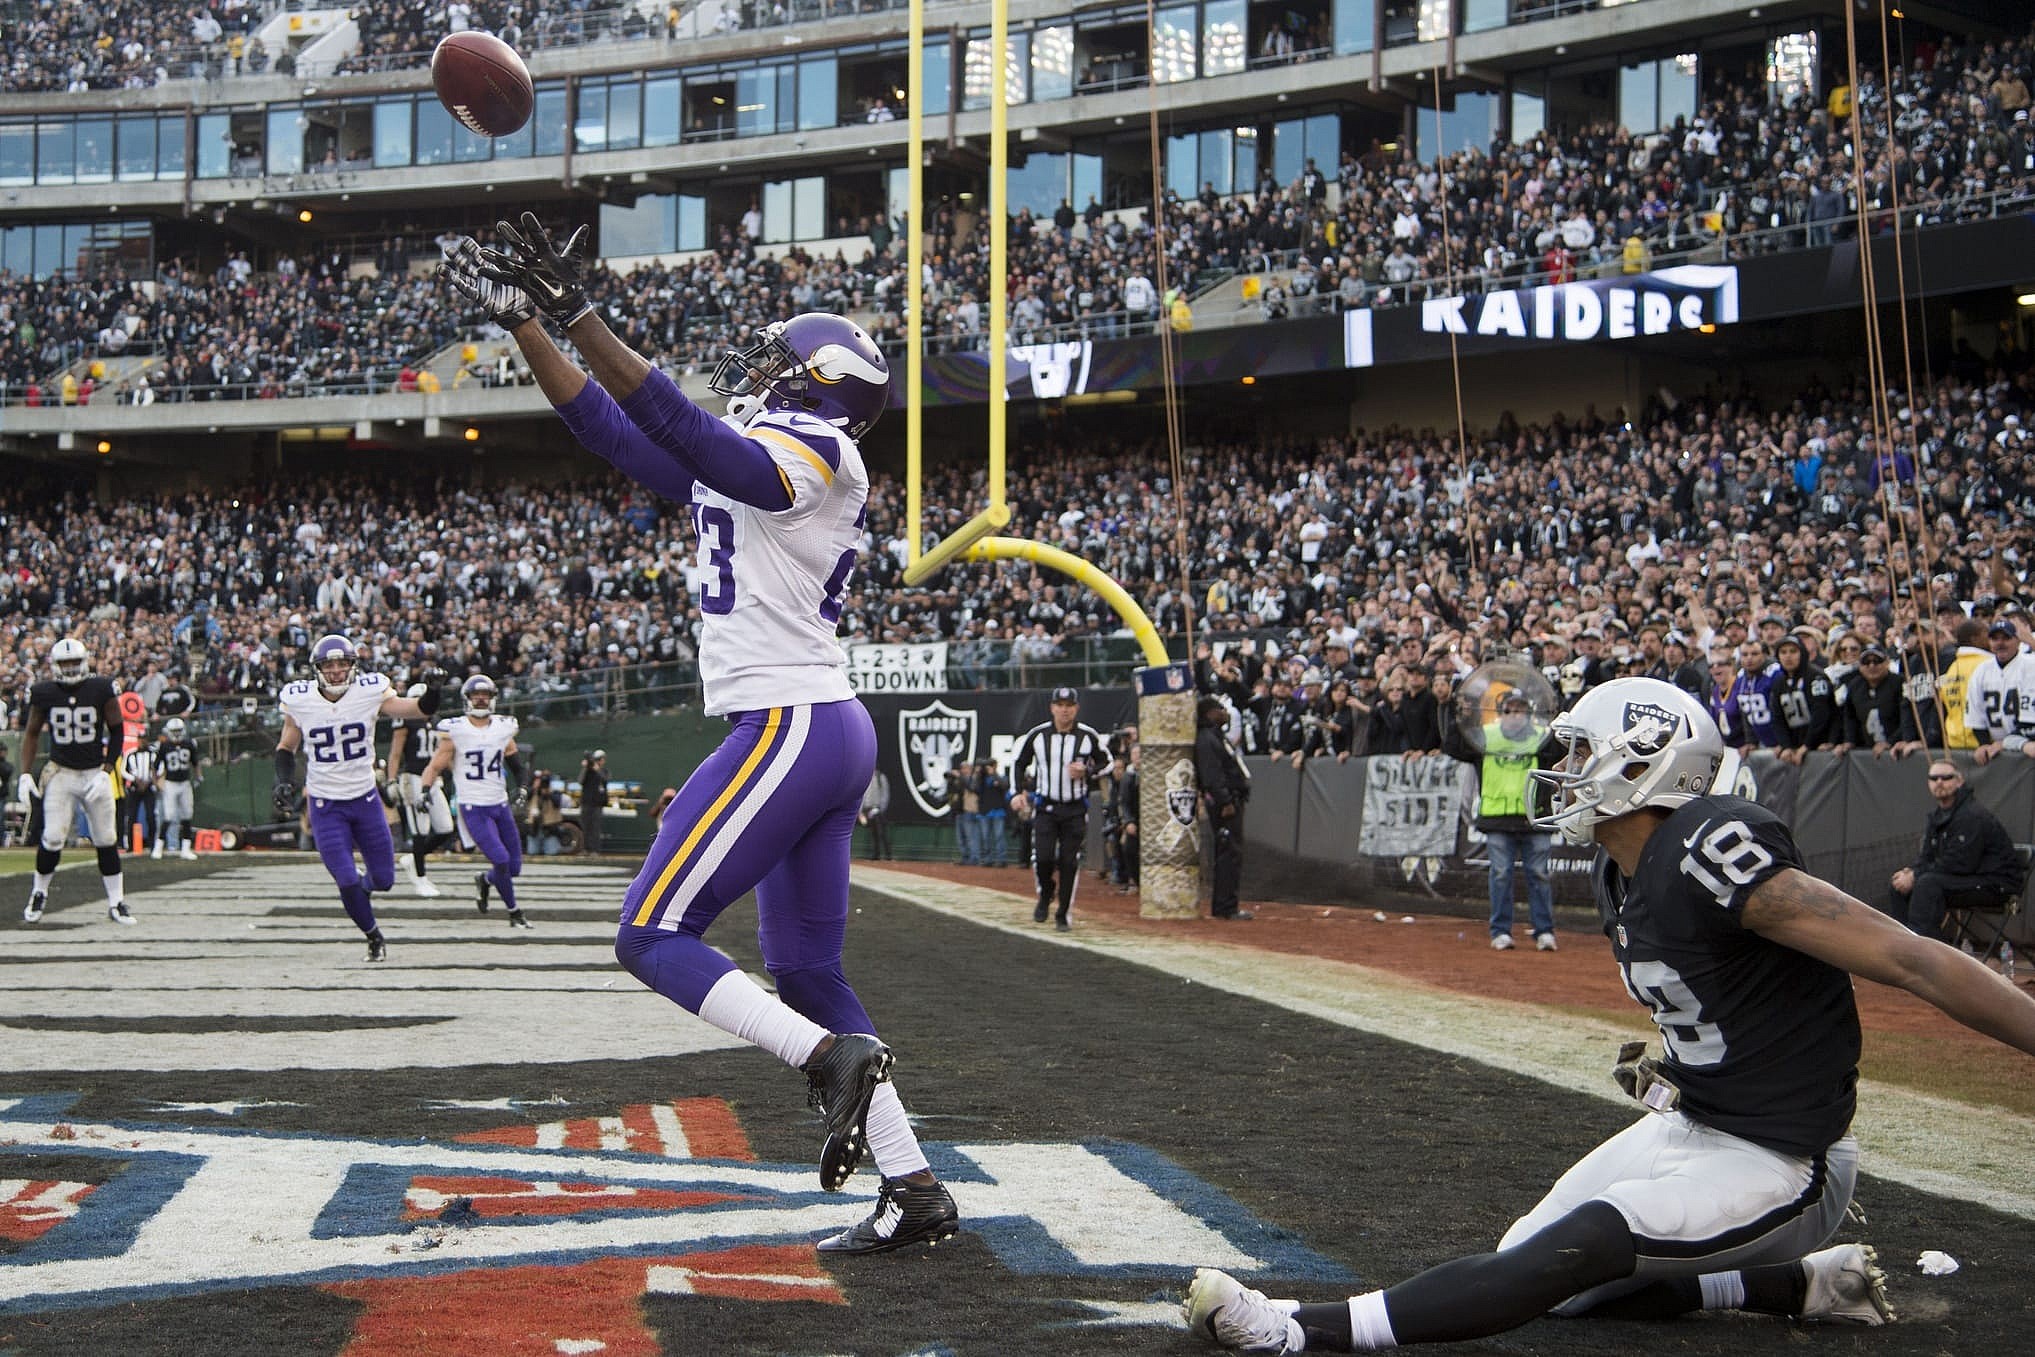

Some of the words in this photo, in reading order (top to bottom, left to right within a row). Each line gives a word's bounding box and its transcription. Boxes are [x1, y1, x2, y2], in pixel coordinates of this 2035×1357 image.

[691, 502, 736, 616] 3
[1629, 703, 1676, 721] RAIDERS
[1983, 687, 2020, 728] 24
[2020, 695, 2035, 711] 2
[50, 705, 98, 744] 88
[909, 717, 968, 732] RAIDERS
[309, 722, 367, 763] 22
[166, 749, 191, 772] 89
[464, 748, 502, 780] 34
[1371, 757, 1459, 791] SILVER
[1379, 796, 1447, 826] SIDE
[1679, 820, 1773, 907] 18
